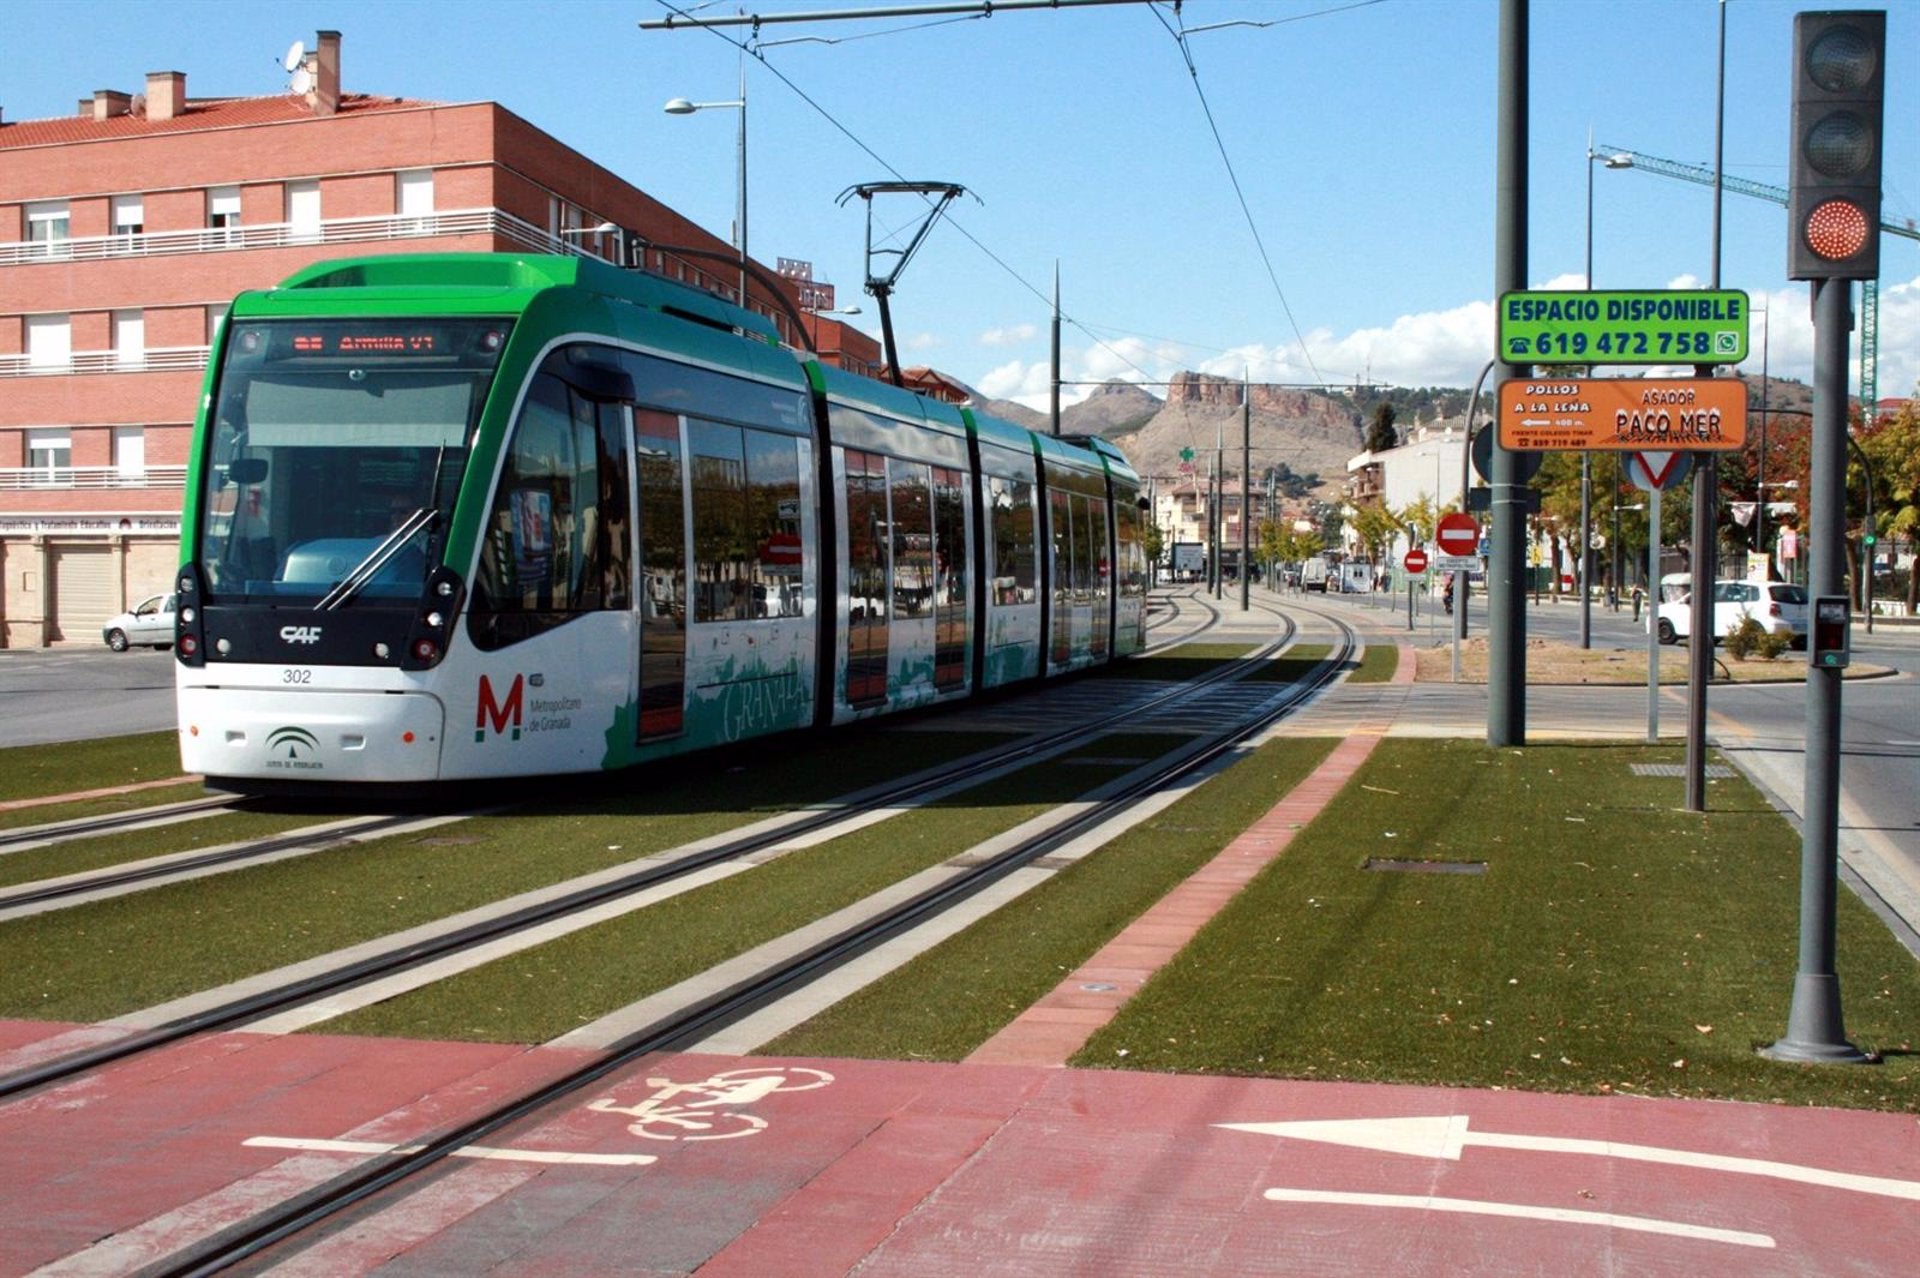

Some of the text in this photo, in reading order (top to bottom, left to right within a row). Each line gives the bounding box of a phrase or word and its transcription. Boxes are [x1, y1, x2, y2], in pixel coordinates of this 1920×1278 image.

[1508, 298, 1740, 321] ESPACIO DISPONIBLE
[1536, 332, 1711, 354] 619 472 758
[1525, 384, 1579, 395] POLLOS
[1642, 390, 1695, 405] ASADOR
[1514, 402, 1525, 413] A
[1530, 402, 1549, 413] LA
[1616, 410, 1721, 434] PACO MER
[280, 626, 322, 644] CAF
[283, 669, 312, 684] 302
[475, 673, 524, 743] M
[530, 697, 582, 716] Metropolitano
[529, 716, 572, 731] de Granada
